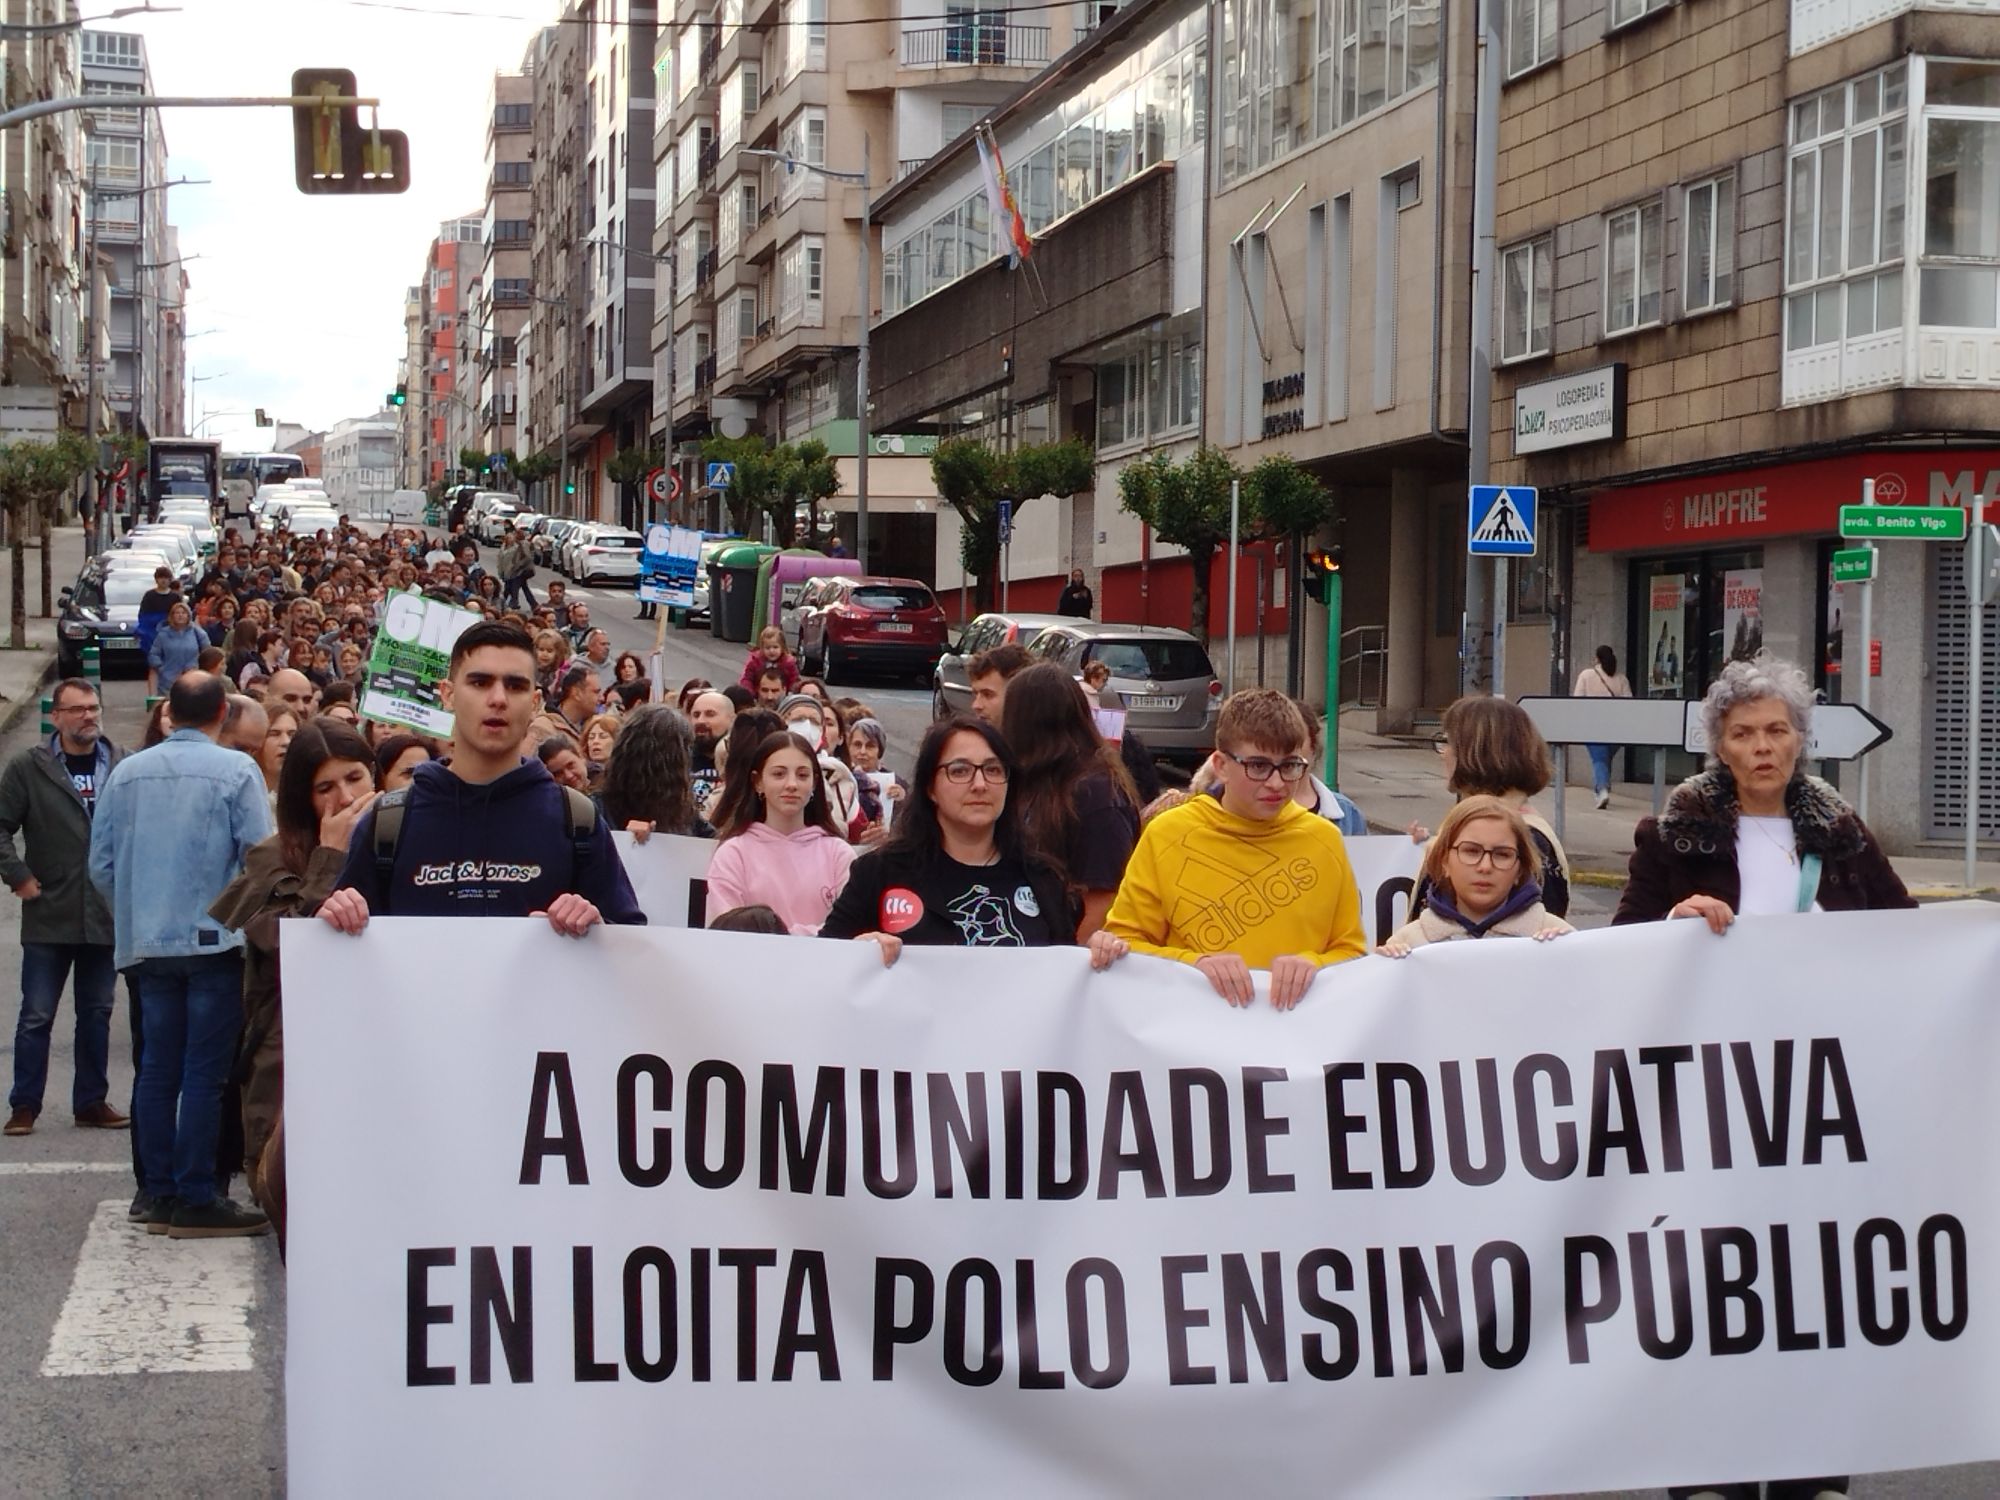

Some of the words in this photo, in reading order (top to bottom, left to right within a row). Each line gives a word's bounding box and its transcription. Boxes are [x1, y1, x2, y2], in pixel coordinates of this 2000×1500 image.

[1683, 486, 1767, 529] MAPFRE
[1845, 518, 1872, 527] avda.
[1877, 516, 1916, 528] Benito
[1921, 517, 1947, 530] Vigo
[519, 1052, 588, 1187] A
[617, 1054, 1295, 1199] COMUNIDADE
[1325, 1038, 1867, 1190] EDUCATIVA
[407, 1246, 533, 1387] EN
[573, 1246, 841, 1383] LOITA
[873, 1257, 1129, 1390] POLO
[1162, 1245, 1531, 1386] ENSINO
[1564, 1213, 1968, 1365] PÚBLICO
